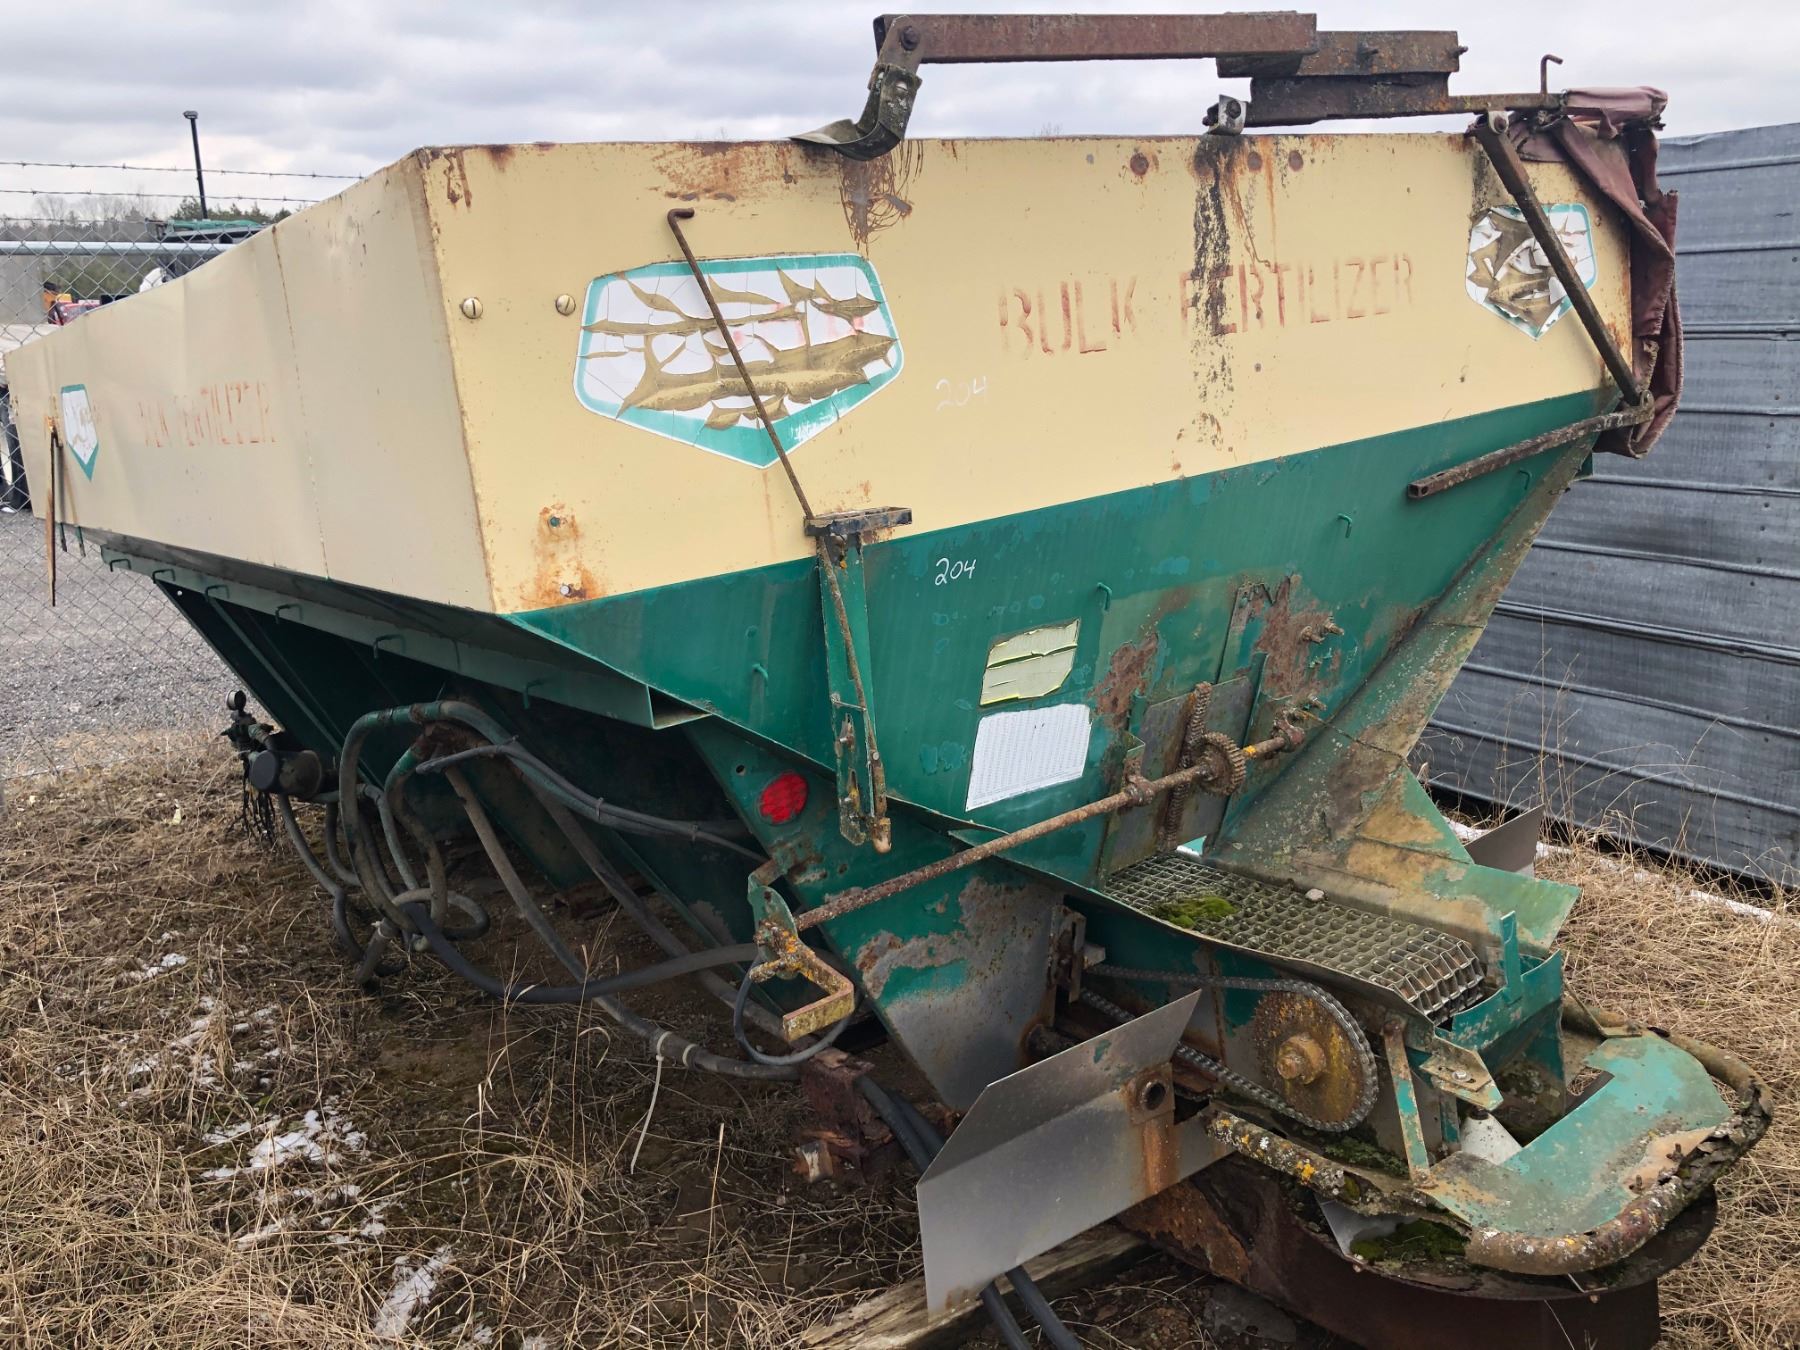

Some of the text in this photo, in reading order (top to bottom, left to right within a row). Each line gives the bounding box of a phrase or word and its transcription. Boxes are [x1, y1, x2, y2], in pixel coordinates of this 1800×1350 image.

[999, 253, 1414, 357] BULK FERTILIZER
[935, 375, 988, 413] 204
[934, 556, 977, 586] 204
